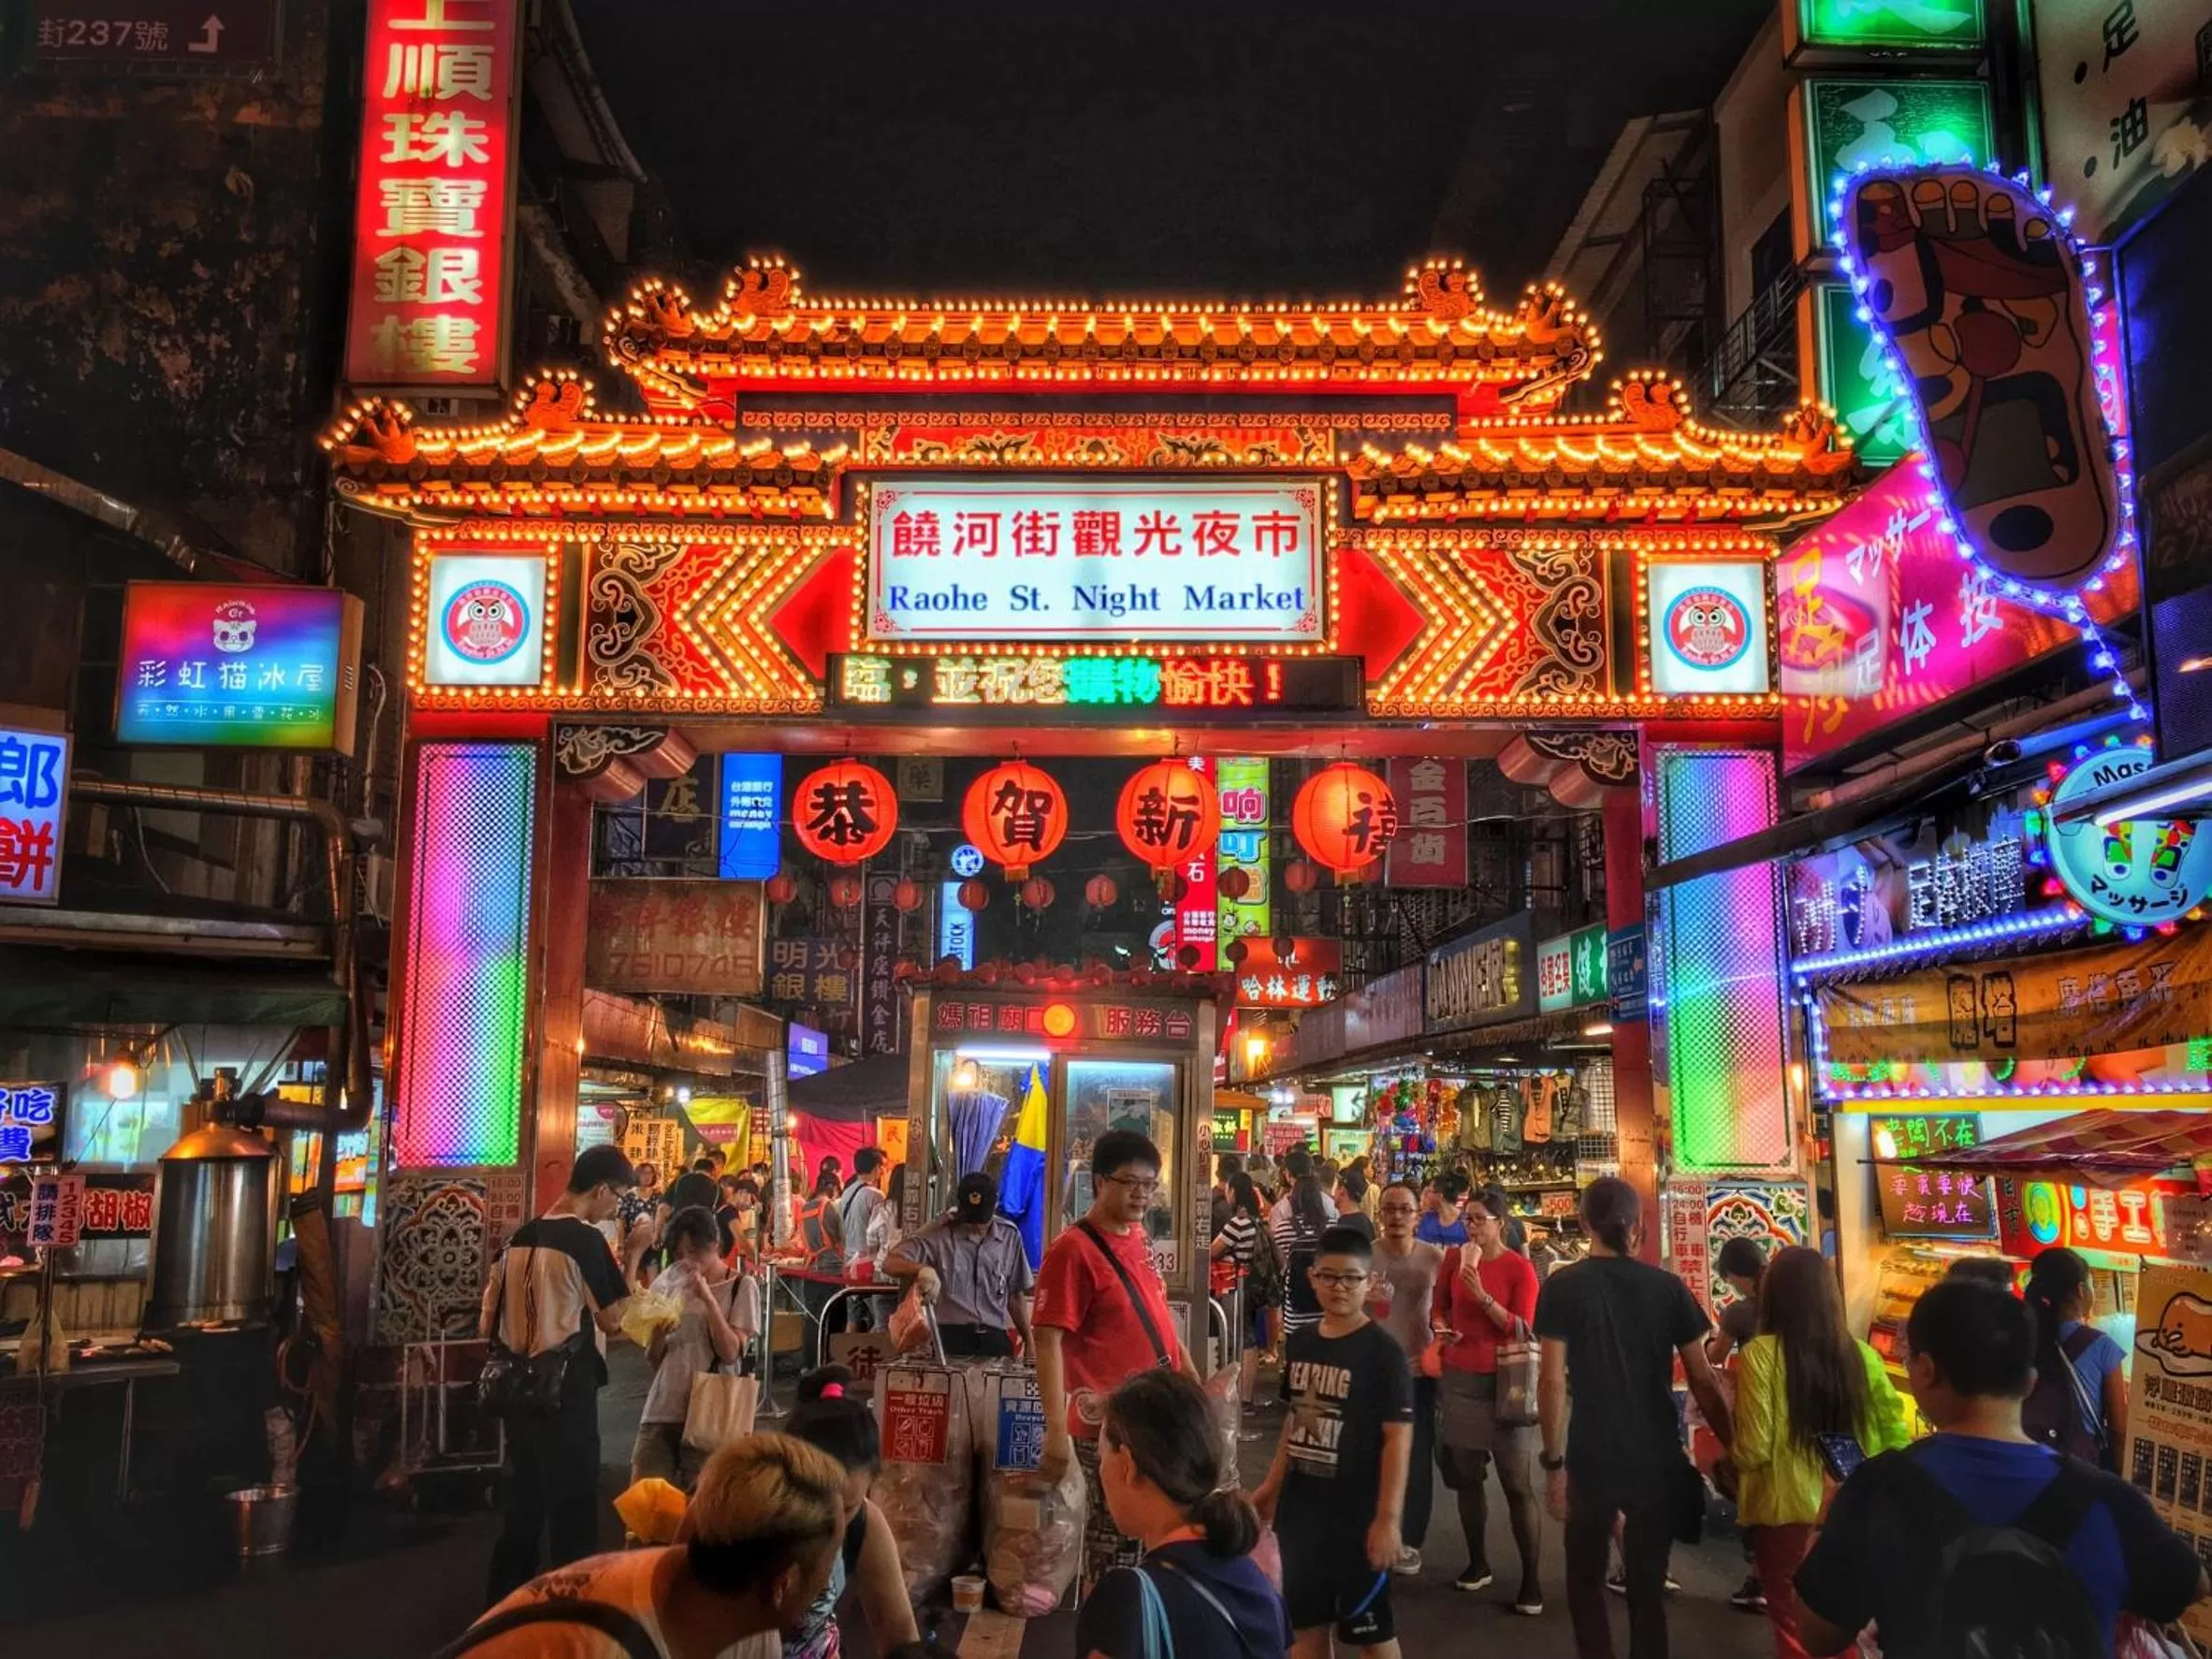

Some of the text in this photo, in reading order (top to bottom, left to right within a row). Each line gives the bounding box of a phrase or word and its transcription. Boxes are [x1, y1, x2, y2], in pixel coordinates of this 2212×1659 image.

[891, 510, 1302, 559] 饒河街觀光夜市
[888, 584, 1304, 618] Raohe St. Night Market
[806, 780, 880, 846] 恭
[992, 779, 1055, 852] 賀
[1133, 787, 1201, 850] 新
[1342, 792, 1398, 858] 禧
[2091, 874, 2190, 914] マッサージ
[1106, 1007, 1192, 1038] 服務台
